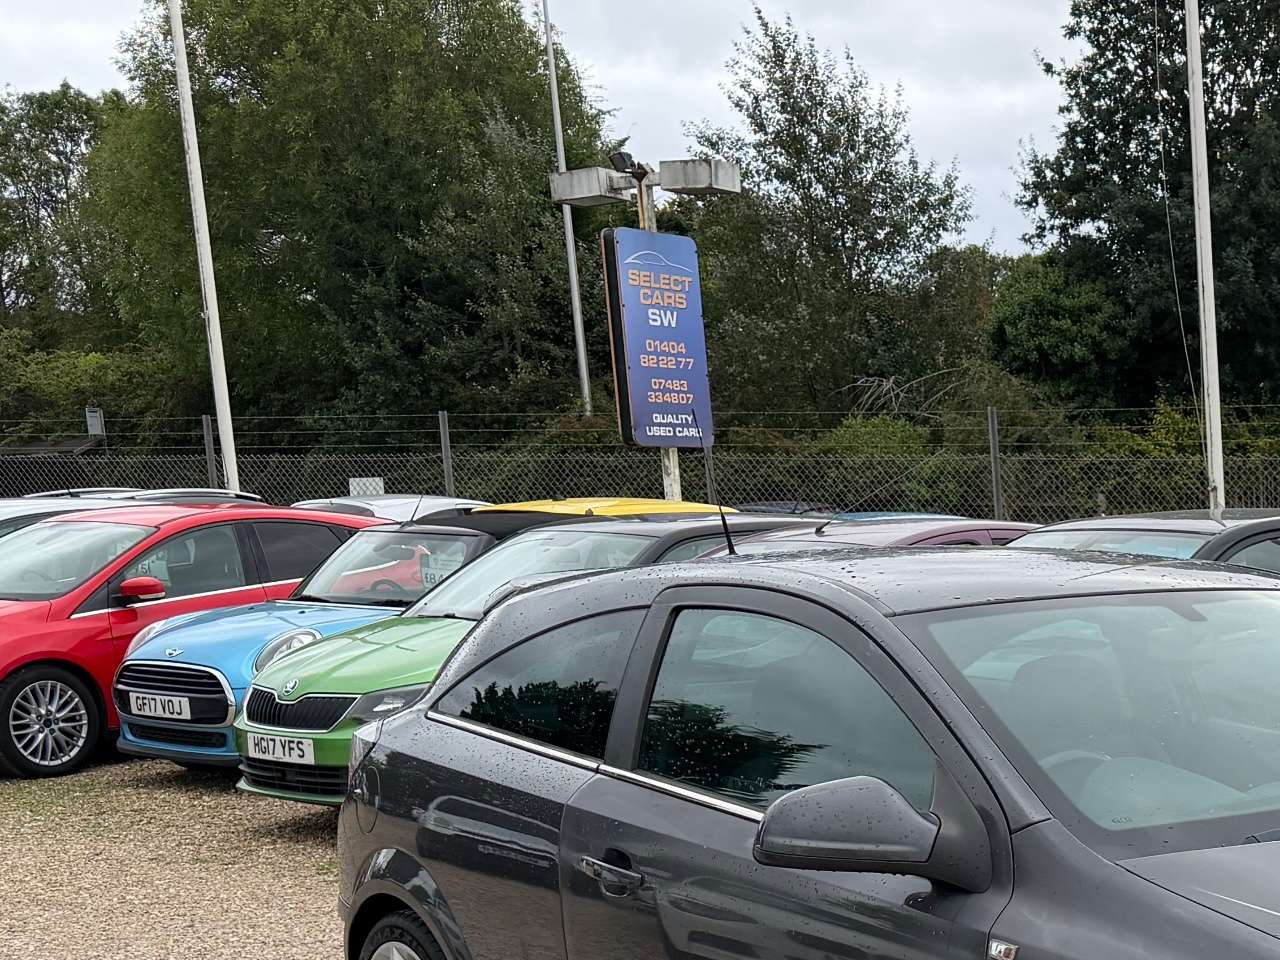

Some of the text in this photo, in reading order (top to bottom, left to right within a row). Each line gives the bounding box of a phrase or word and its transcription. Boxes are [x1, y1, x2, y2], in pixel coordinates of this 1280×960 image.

[627, 269, 693, 291] SELECT
[639, 287, 689, 309] CARS
[647, 308, 678, 328] SW
[645, 339, 687, 354] 01404
[651, 378, 689, 391] 07483
[647, 391, 695, 404] 334807
[652, 412, 694, 425] QUALITY
[646, 425, 674, 436] USED
[135, 692, 183, 716] GF17 VOJ
[253, 735, 305, 758] HG17 YFS
